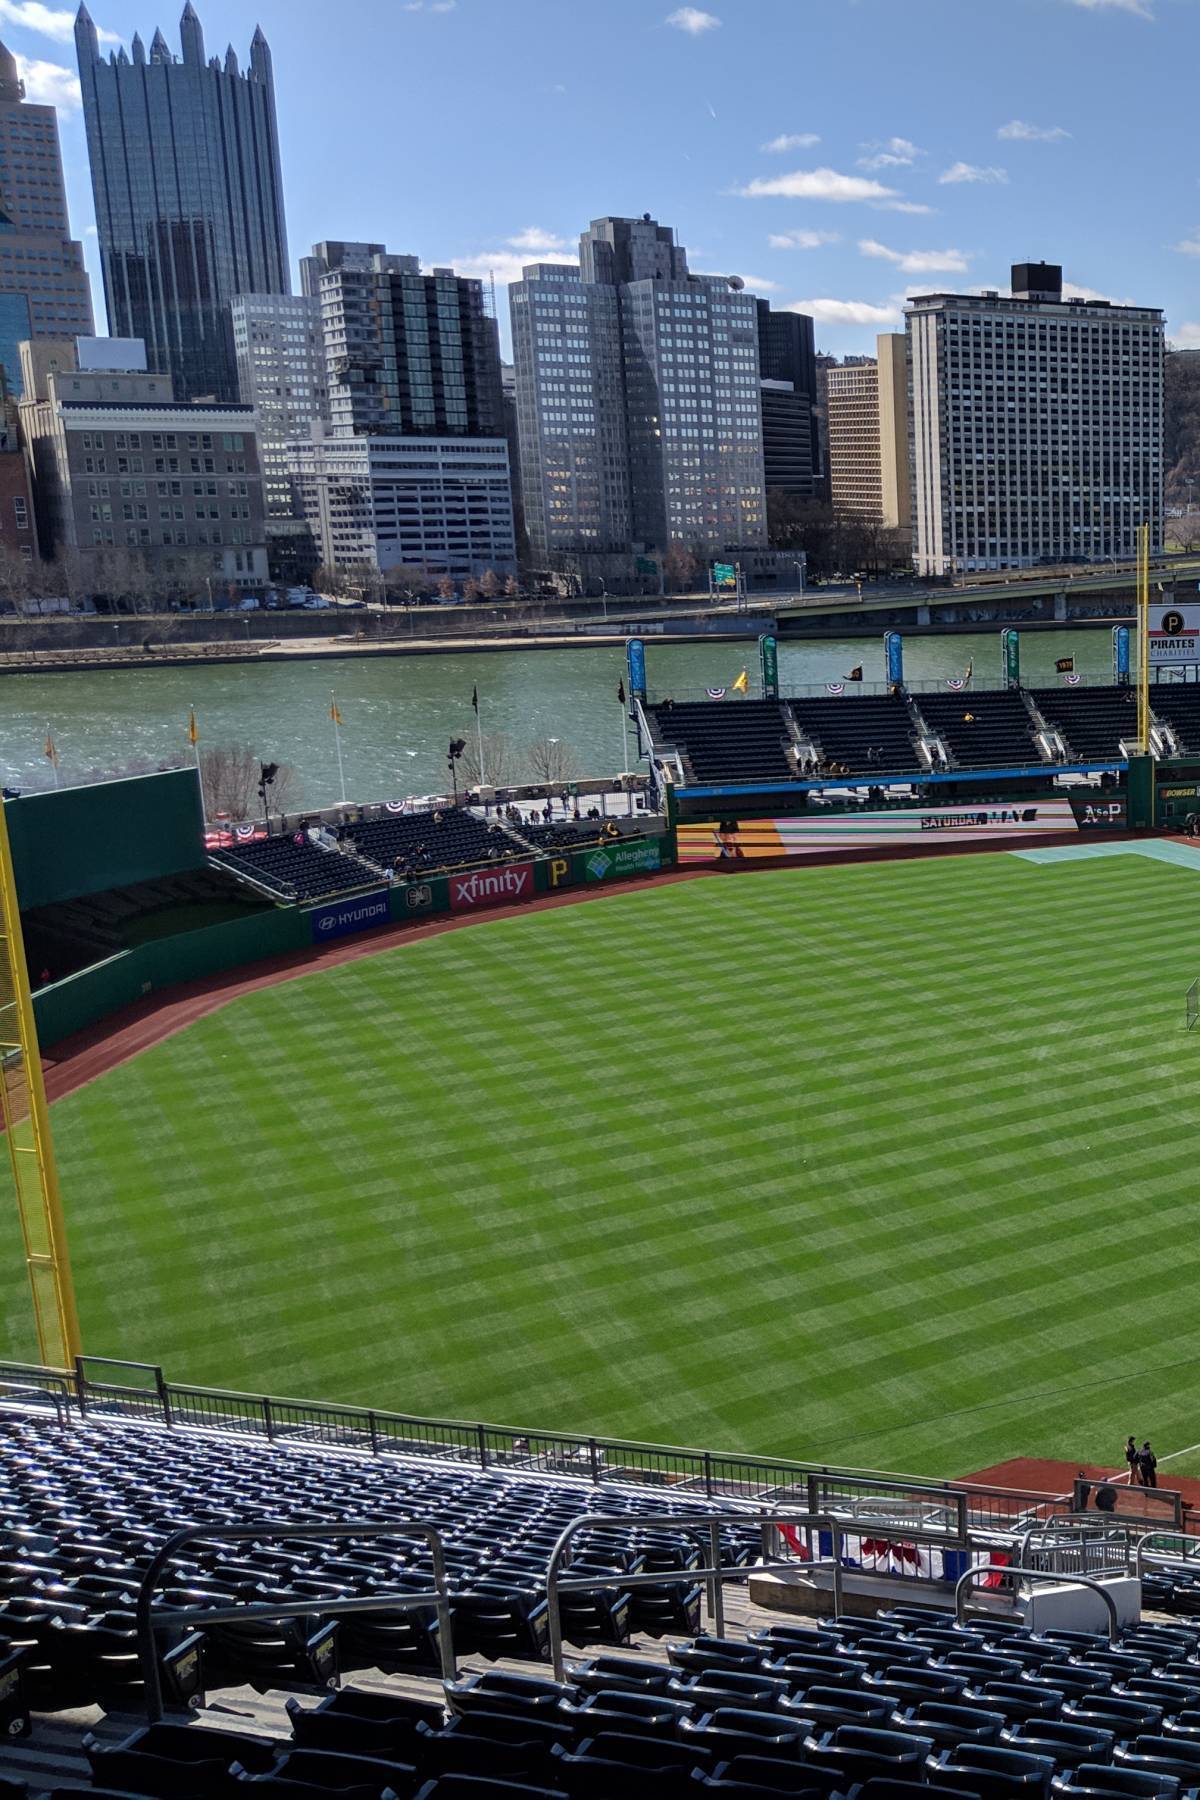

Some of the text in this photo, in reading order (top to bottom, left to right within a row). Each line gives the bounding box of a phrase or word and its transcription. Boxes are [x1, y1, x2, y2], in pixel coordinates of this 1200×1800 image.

[1168, 617, 1178, 631] P
[1150, 639, 1195, 649] PIRATES
[1150, 649, 1195, 657] CHARITIES
[1166, 788, 1196, 797] BOWSER
[615, 847, 660, 862] Allegheny
[456, 870, 528, 903] xfinity
[338, 902, 387, 925] HYUNDAI
